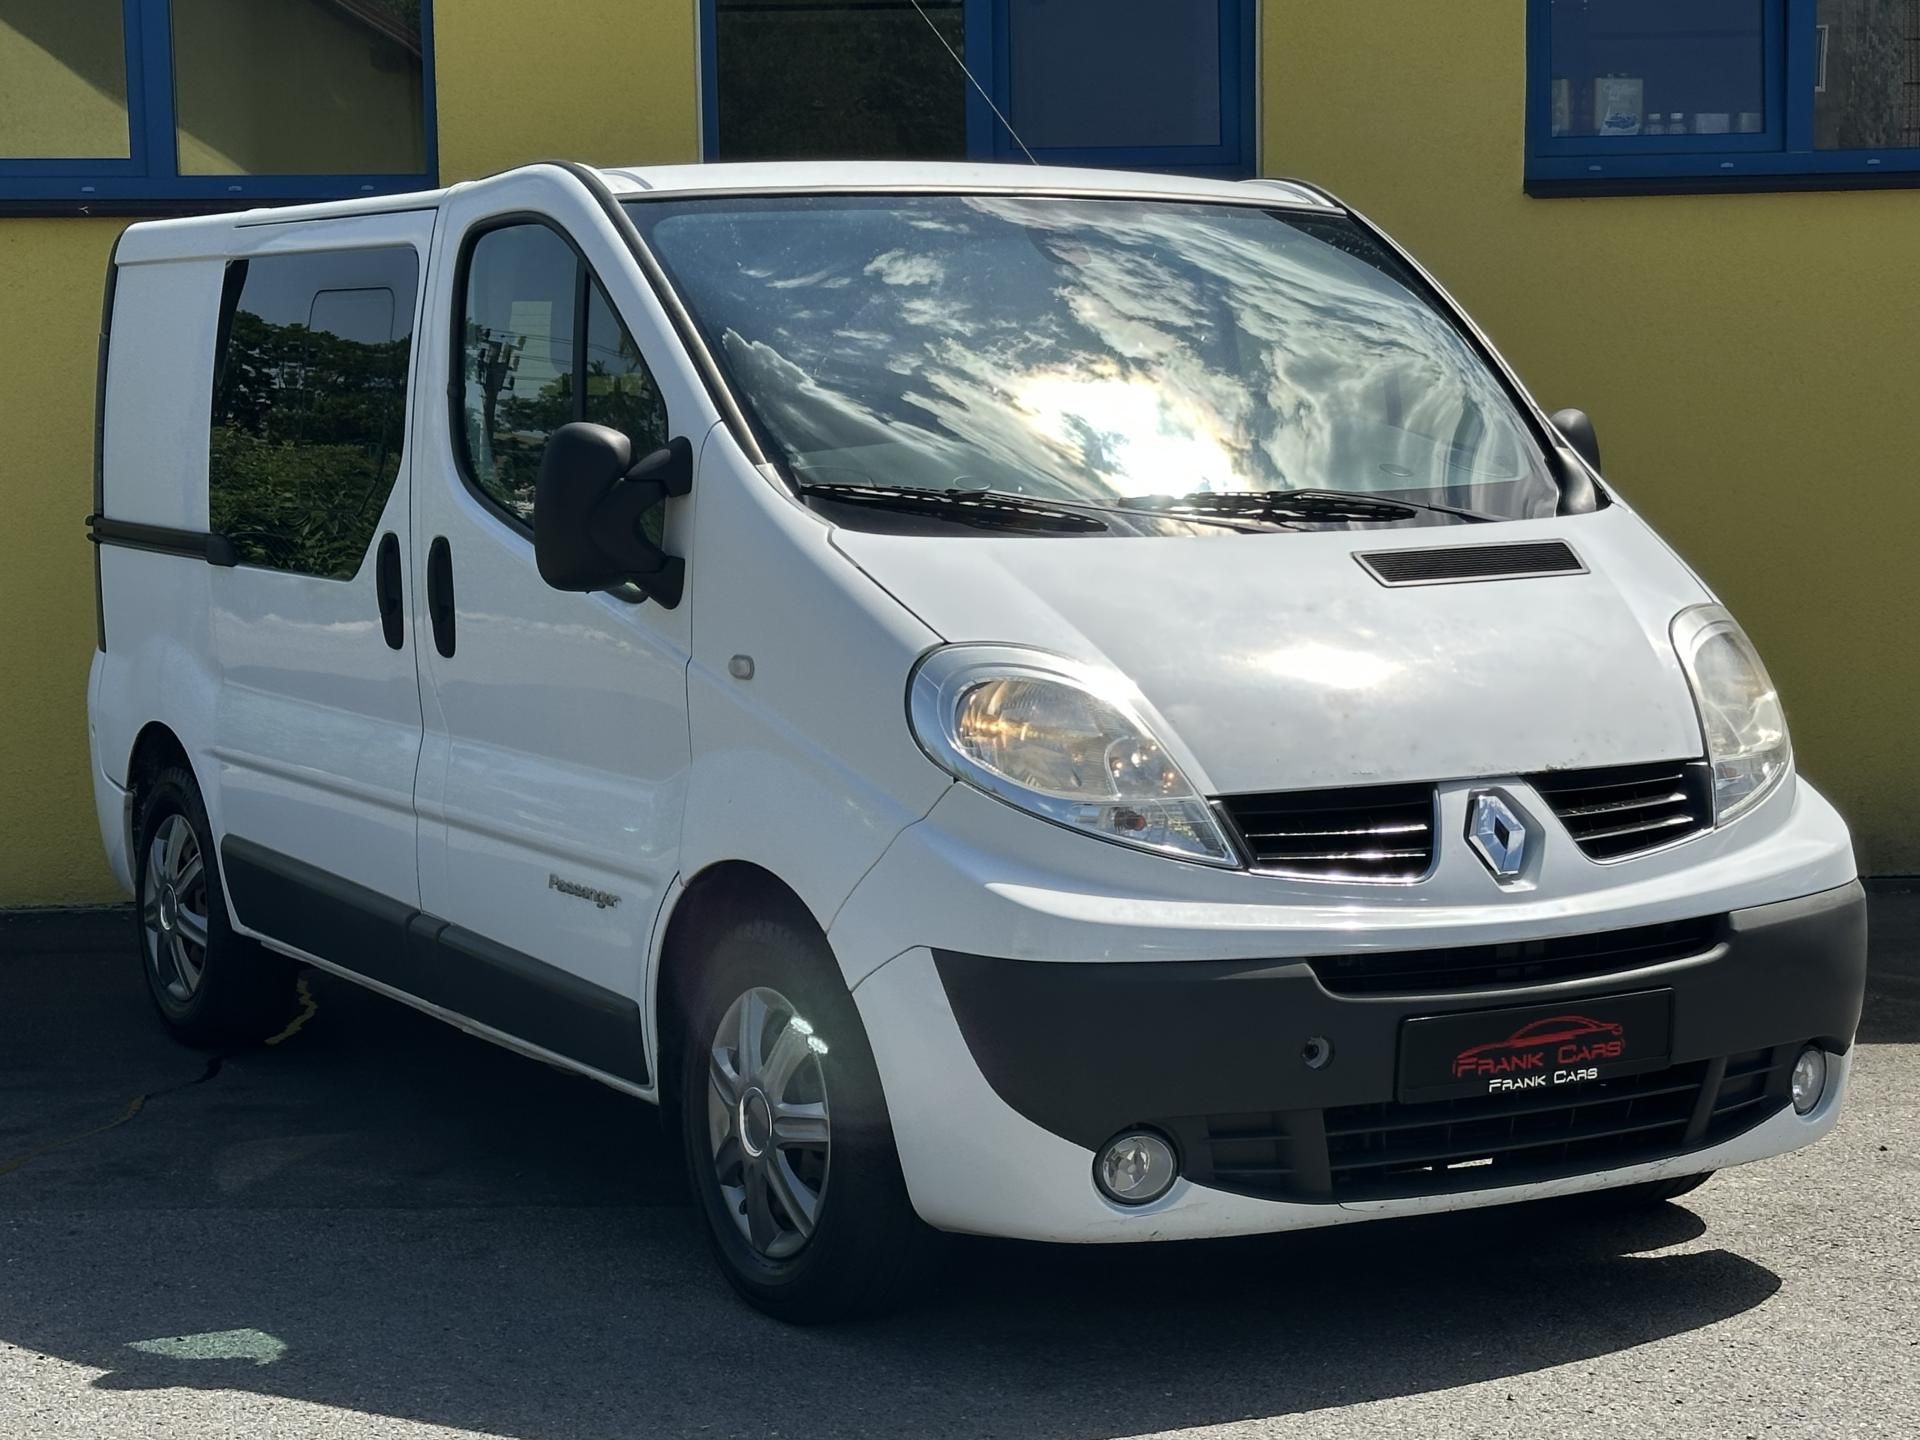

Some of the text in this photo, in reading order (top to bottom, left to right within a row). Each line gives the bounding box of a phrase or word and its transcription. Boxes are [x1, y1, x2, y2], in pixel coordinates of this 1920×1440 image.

[1457, 1040, 1623, 1078] FRANK CARS
[1488, 1067, 1599, 1093] FRANK CARS
